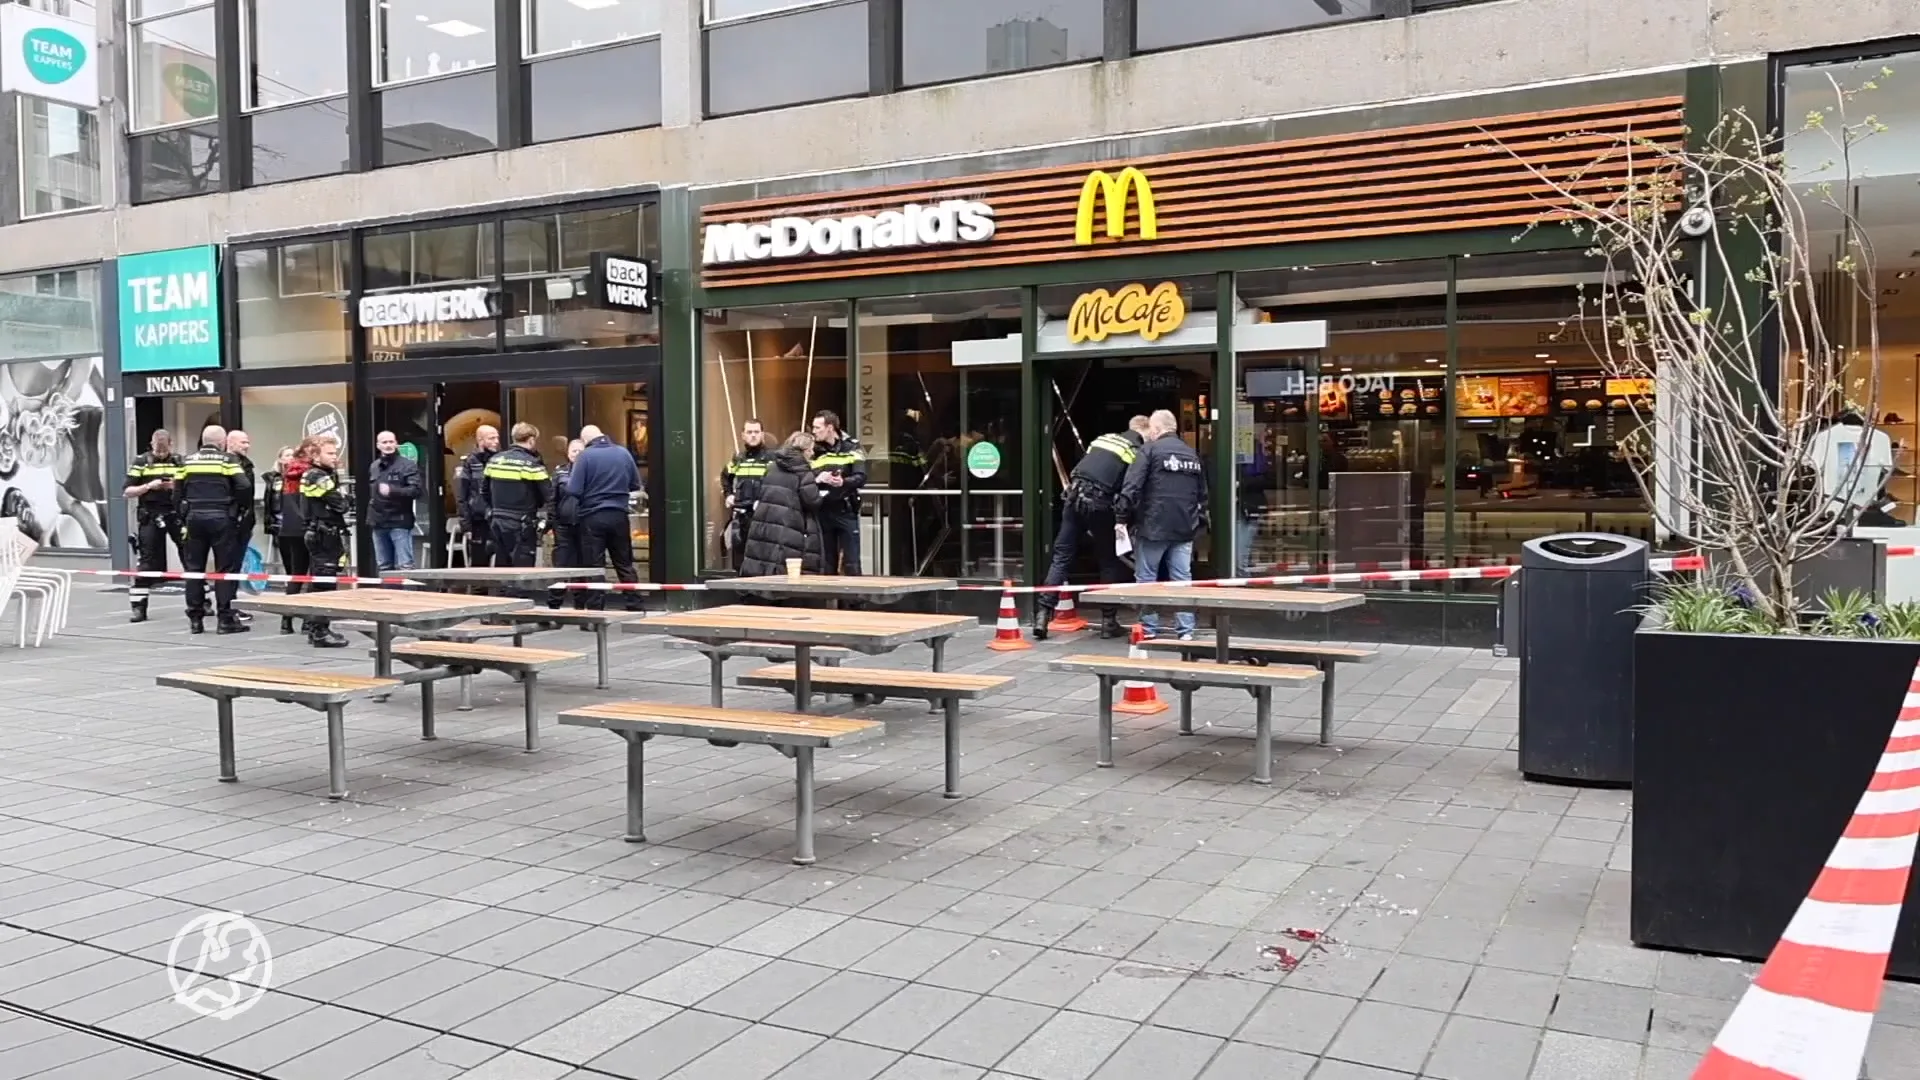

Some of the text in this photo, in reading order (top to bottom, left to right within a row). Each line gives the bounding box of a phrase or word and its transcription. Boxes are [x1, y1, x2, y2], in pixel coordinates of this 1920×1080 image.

[31, 38, 73, 60] TEAM
[702, 199, 995, 264] McDonald's
[610, 259, 645, 284] back
[127, 271, 209, 314] TEAM
[606, 283, 648, 308] WERK
[1073, 289, 1173, 336] McCafé
[134, 319, 209, 348] KAPPERS
[146, 374, 201, 393] INGANG
[862, 364, 873, 436] DANK U
